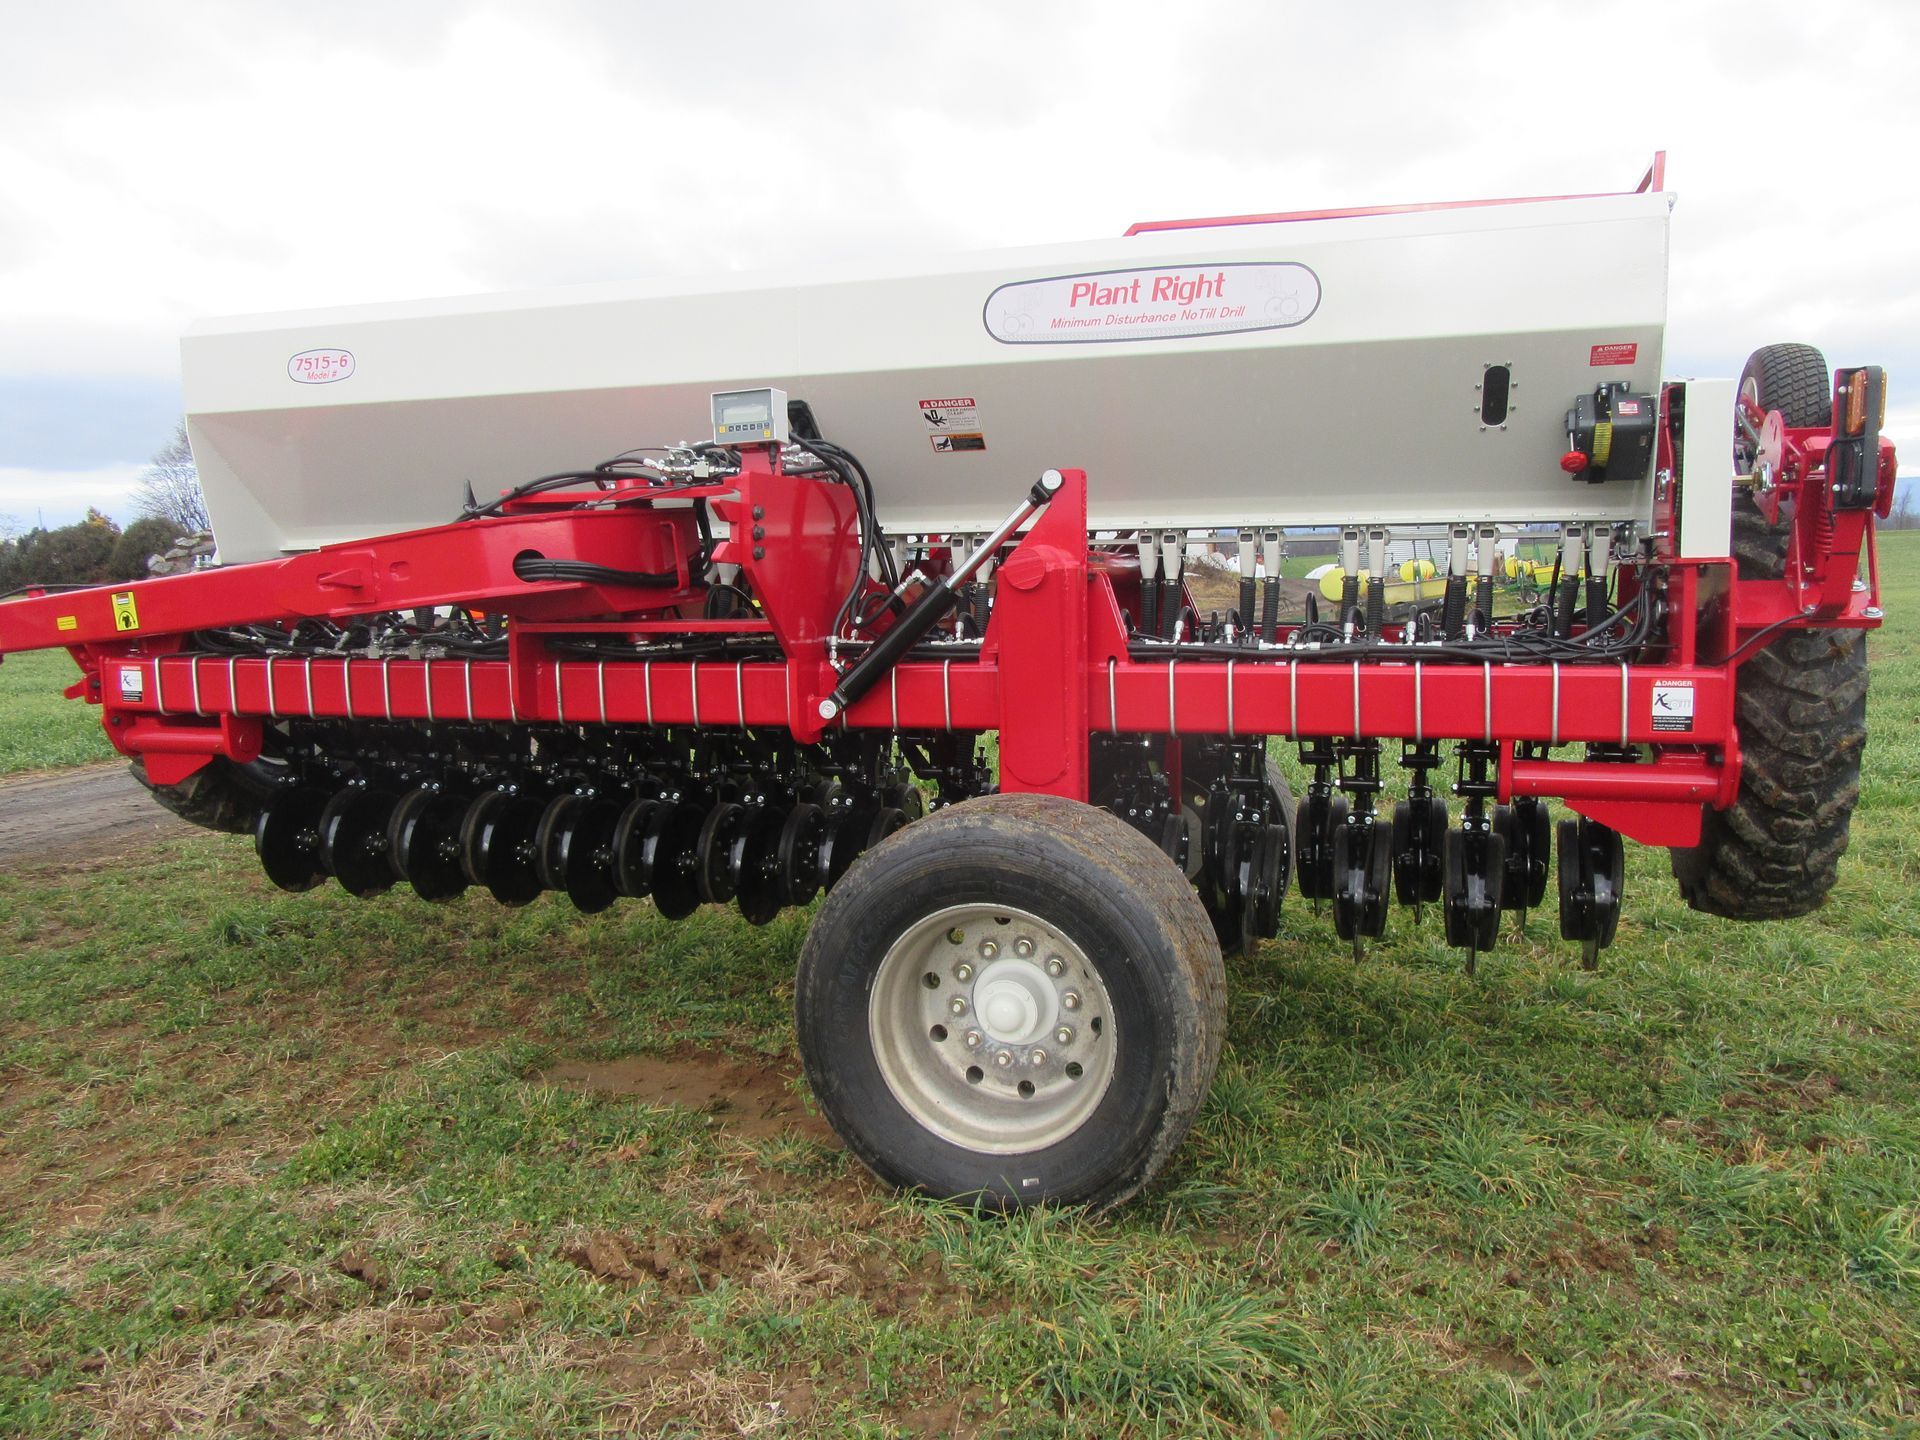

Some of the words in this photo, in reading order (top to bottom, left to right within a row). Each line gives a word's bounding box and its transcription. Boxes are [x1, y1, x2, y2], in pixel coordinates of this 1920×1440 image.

[1070, 279, 1141, 307] Plant
[1152, 272, 1225, 306] Right
[1051, 316, 1101, 329] Minimum
[1105, 312, 1177, 325] Disturbance
[1220, 305, 1246, 318] Drill
[296, 354, 348, 371] 7515-6
[307, 371, 330, 380] Model
[931, 399, 972, 407] DANGER
